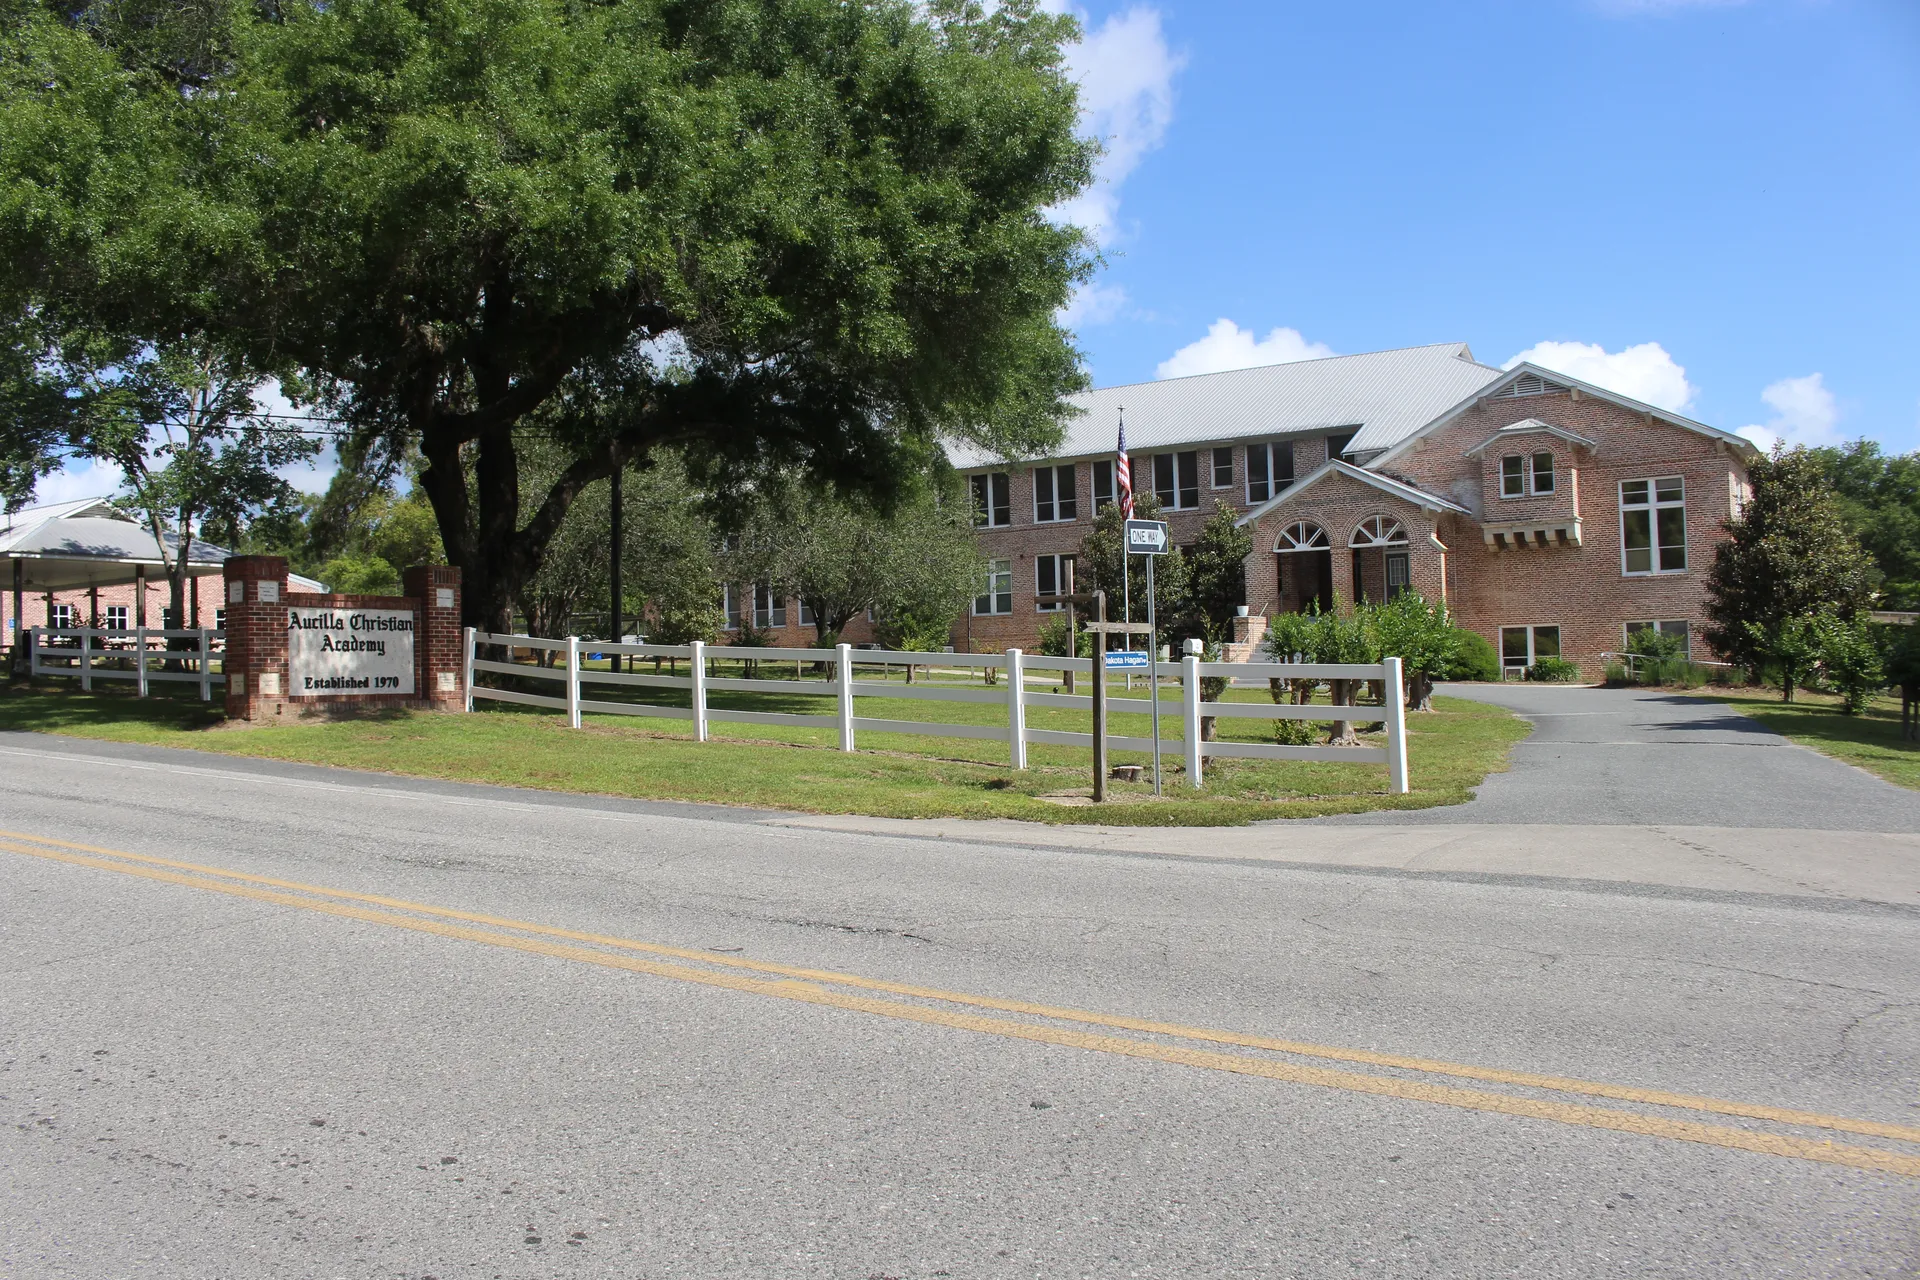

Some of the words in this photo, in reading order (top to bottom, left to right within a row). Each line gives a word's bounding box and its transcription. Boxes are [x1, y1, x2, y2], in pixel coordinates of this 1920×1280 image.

[1132, 530, 1146, 543] ONE
[1147, 531, 1158, 543] WAY
[287, 612, 344, 630] Aucilla
[350, 614, 413, 632] Christian
[320, 634, 386, 656] Academy
[1124, 656, 1143, 666] Hagan
[304, 677, 369, 689] Established
[374, 676, 399, 688] 1970
